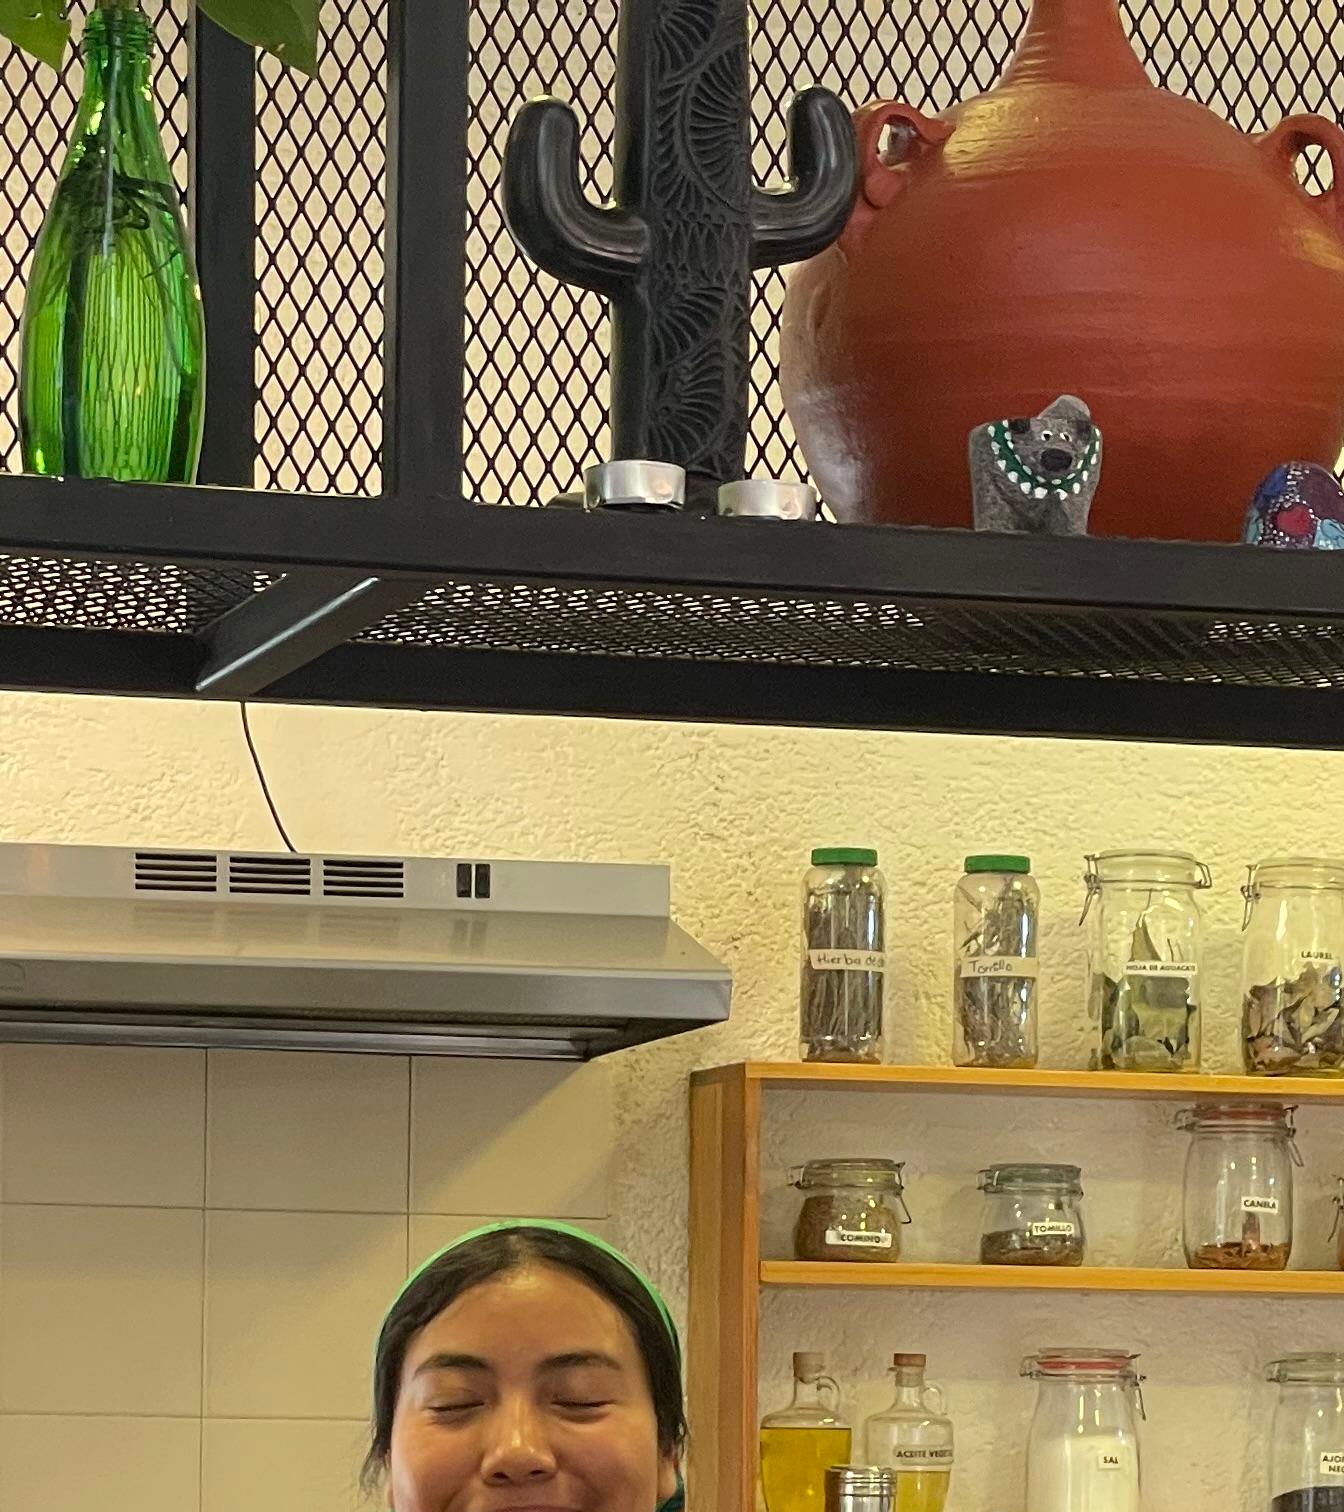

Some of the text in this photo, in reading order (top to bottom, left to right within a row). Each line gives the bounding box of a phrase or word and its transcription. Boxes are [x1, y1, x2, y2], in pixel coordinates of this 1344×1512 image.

[1301, 951, 1333, 960] LAUREL
[1244, 1199, 1276, 1209] CANELA
[896, 1450, 926, 1458] ACEITE
[1103, 1456, 1119, 1464] SAL
